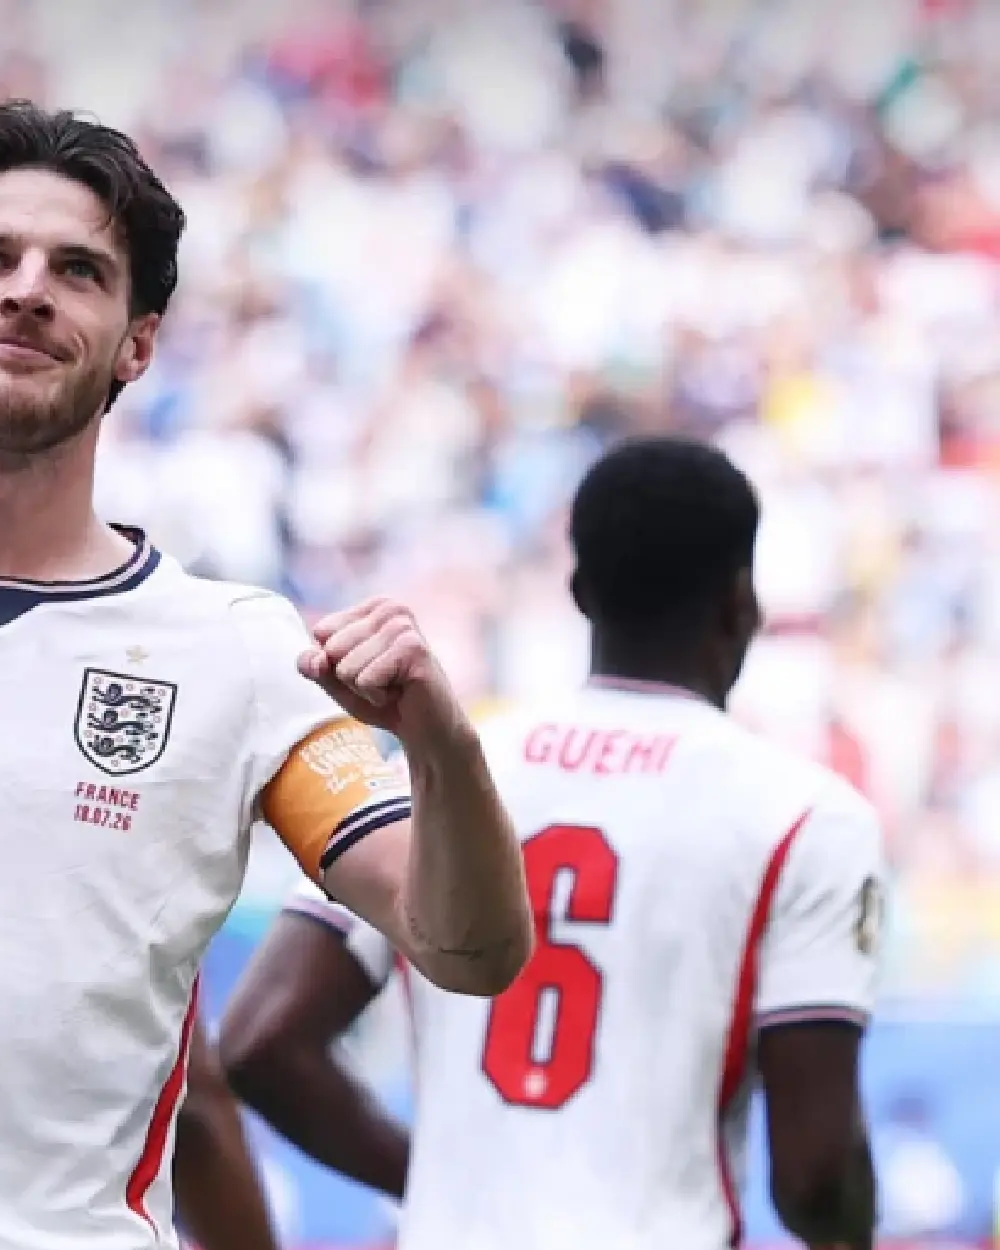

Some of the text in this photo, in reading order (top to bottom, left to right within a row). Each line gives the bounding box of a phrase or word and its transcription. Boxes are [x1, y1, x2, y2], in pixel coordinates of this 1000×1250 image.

[524, 723, 679, 776] GUEHI
[74, 782, 141, 811] FRANCE
[74, 804, 132, 832] 18.07.26
[481, 823, 620, 1111] 6
